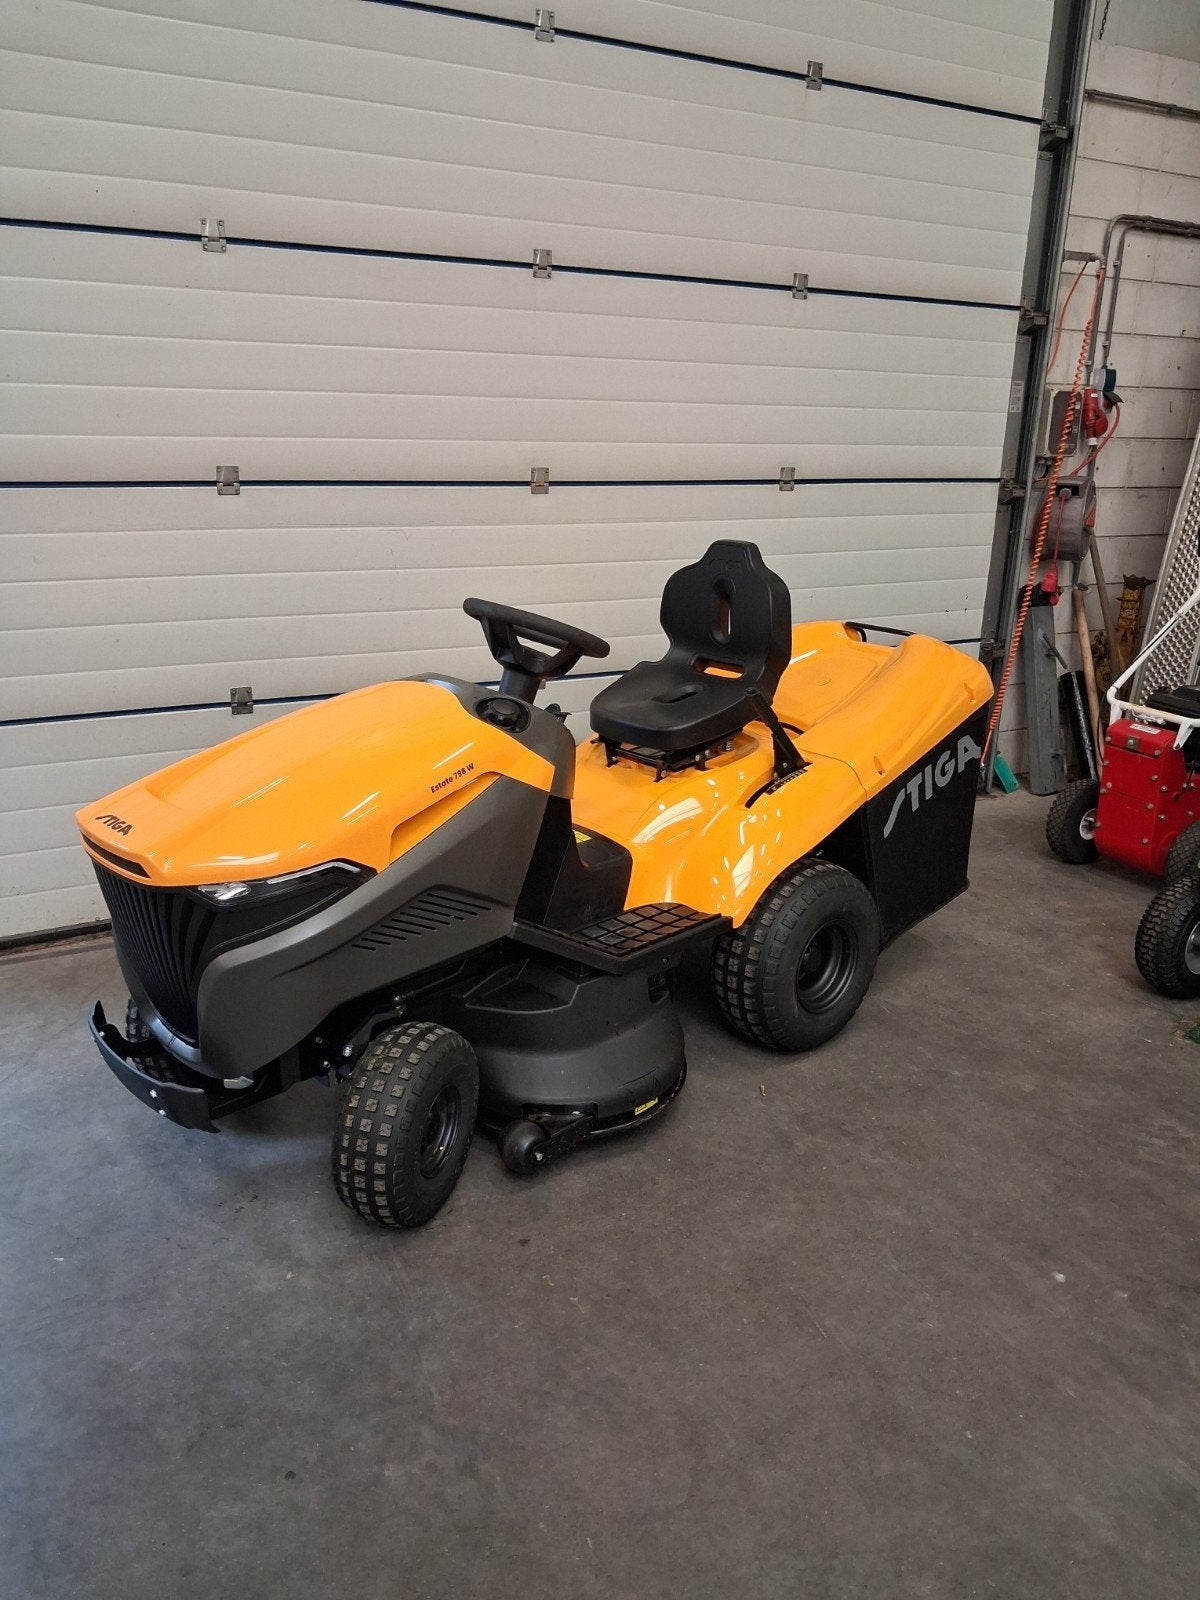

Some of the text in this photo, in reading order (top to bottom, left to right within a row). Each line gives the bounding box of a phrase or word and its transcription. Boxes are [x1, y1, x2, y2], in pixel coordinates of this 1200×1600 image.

[430, 762, 474, 793] Estate 798 W
[883, 734, 981, 838] STIGA
[95, 814, 133, 836] STIGA
